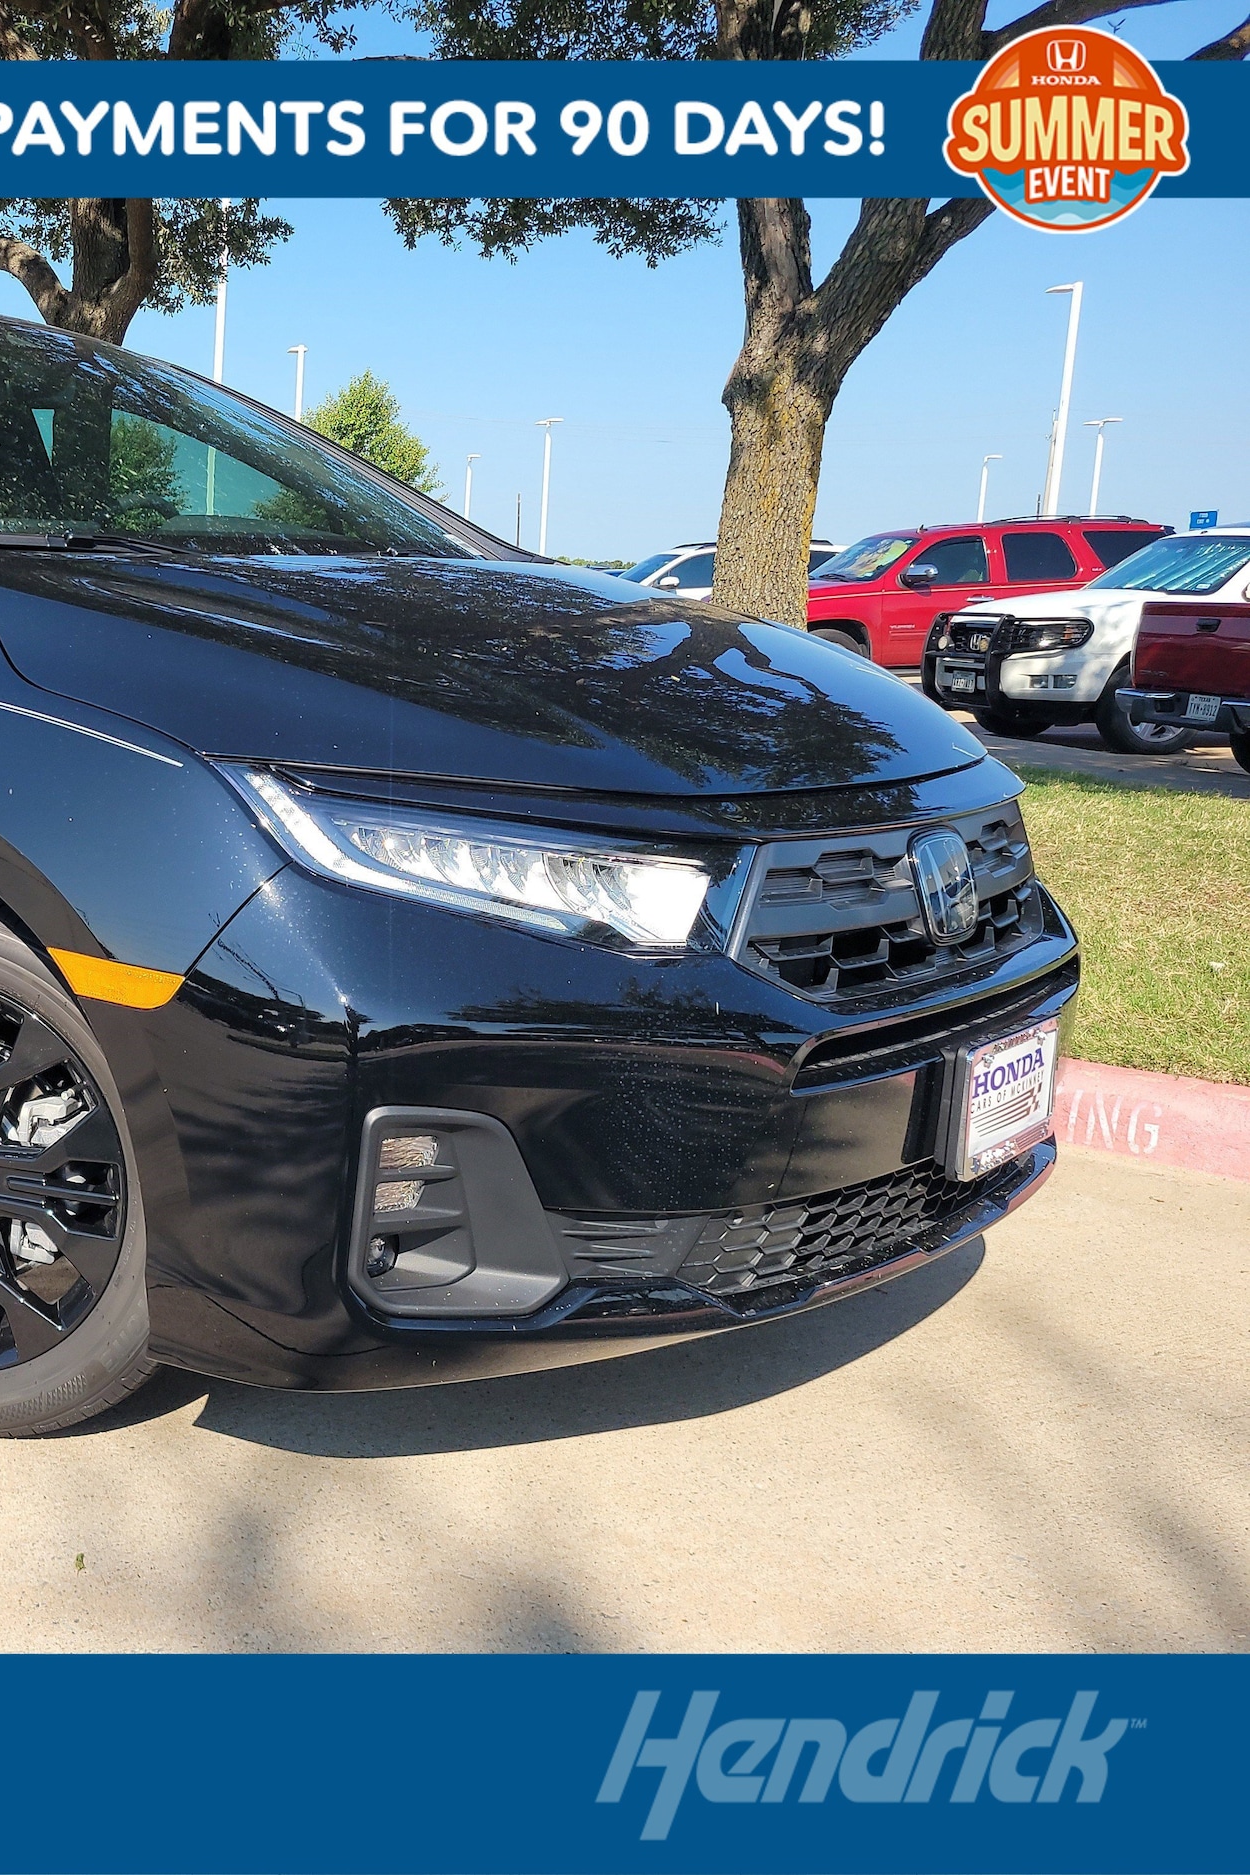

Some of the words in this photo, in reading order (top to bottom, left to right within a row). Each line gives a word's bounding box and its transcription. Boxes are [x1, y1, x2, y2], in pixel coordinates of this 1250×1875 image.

[970, 1098, 992, 1114] CARS
[997, 1091, 1007, 1104] OF
[1011, 1070, 1045, 1098] MCKINNEY
[972, 1048, 1045, 1099] HONDA
[1056, 1084, 1162, 1154] ING
